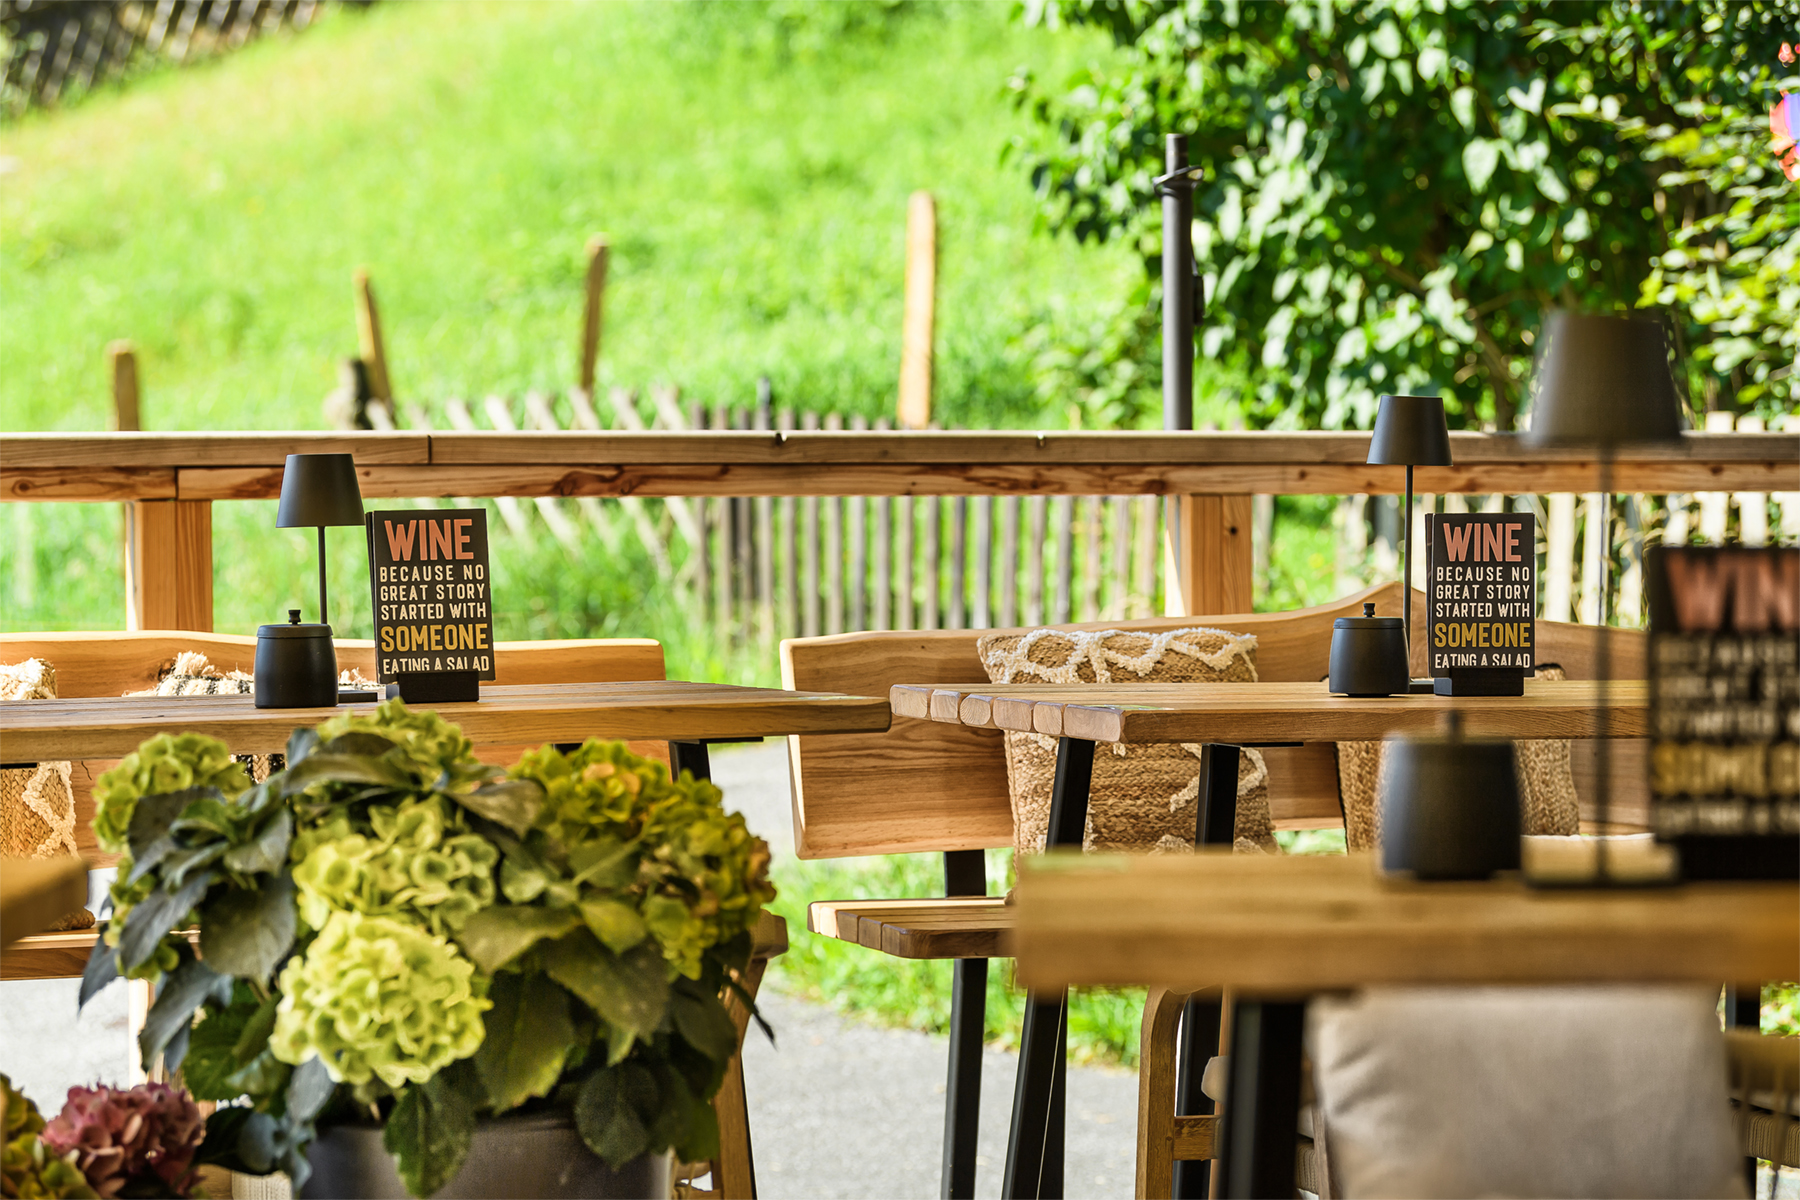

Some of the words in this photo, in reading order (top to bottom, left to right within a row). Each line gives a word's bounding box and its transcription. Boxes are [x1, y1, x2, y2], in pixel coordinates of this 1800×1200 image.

[384, 519, 474, 561] WINE
[1443, 522, 1522, 562] WINE
[380, 565, 454, 582] BECAUSE
[463, 564, 485, 580] NO
[1436, 566, 1503, 582] BECAUSE
[1511, 566, 1530, 581] NO
[380, 585, 429, 601] GREAT
[435, 583, 485, 600] STORY
[1436, 585, 1480, 600] GREAT
[1486, 585, 1530, 600] STORY
[381, 603, 444, 620] STARTED
[449, 602, 487, 619] WITH
[1436, 603, 1493, 618] STARTED
[1498, 603, 1530, 618] WITH
[381, 623, 488, 652] SOMEONE
[1434, 622, 1531, 648] SOMEONE
[382, 657, 430, 675] EATING
[434, 657, 443, 671] A
[1435, 653, 1477, 669] EATING
[1481, 653, 1488, 667] A
